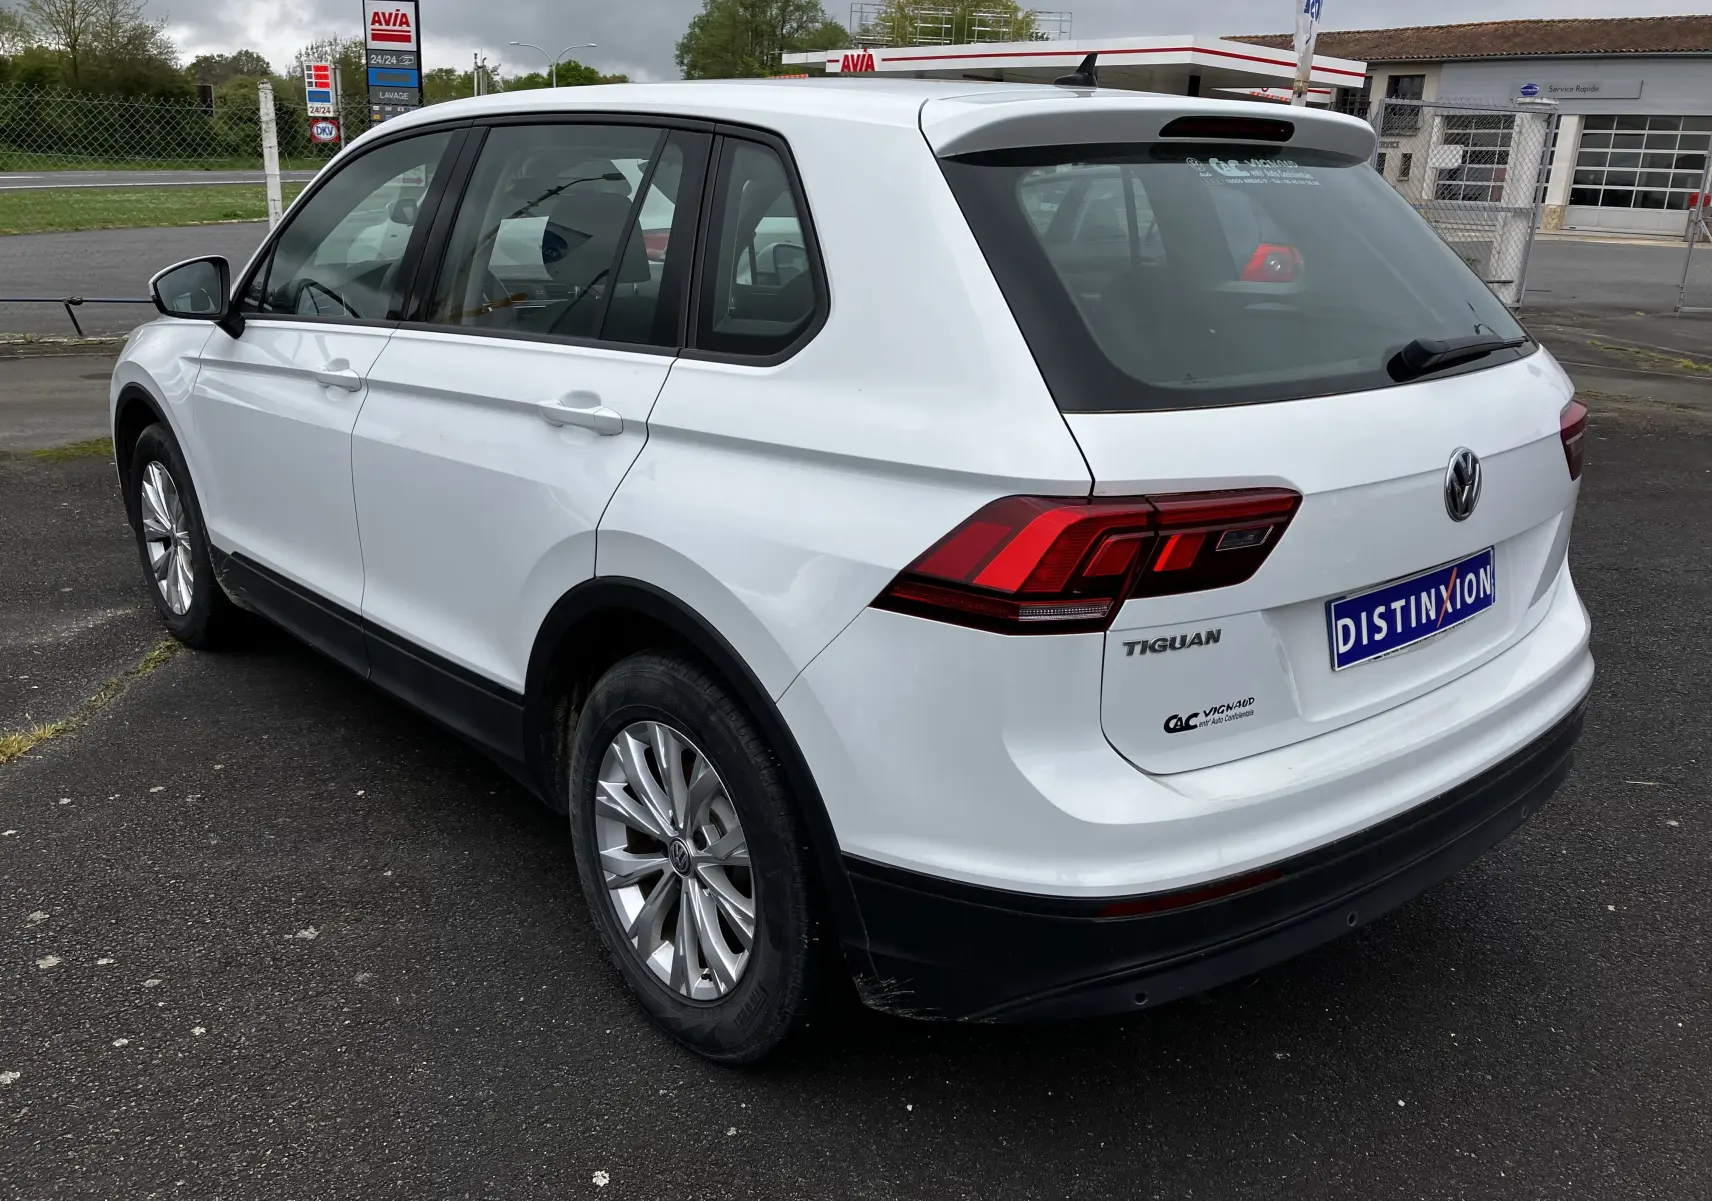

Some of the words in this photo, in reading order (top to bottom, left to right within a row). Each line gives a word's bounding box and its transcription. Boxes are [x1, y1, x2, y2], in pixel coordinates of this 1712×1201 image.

[370, 55, 397, 64] 24/24
[1548, 85, 1574, 93] Service
[1575, 84, 1599, 94] Rapide
[379, 91, 409, 100] LAVAGE
[310, 106, 331, 114] 24/24
[316, 128, 333, 136] DKV
[1336, 564, 1492, 655] DISTINXION
[1122, 628, 1222, 657] TIGUAN
[1203, 696, 1255, 718] VIGNAUD
